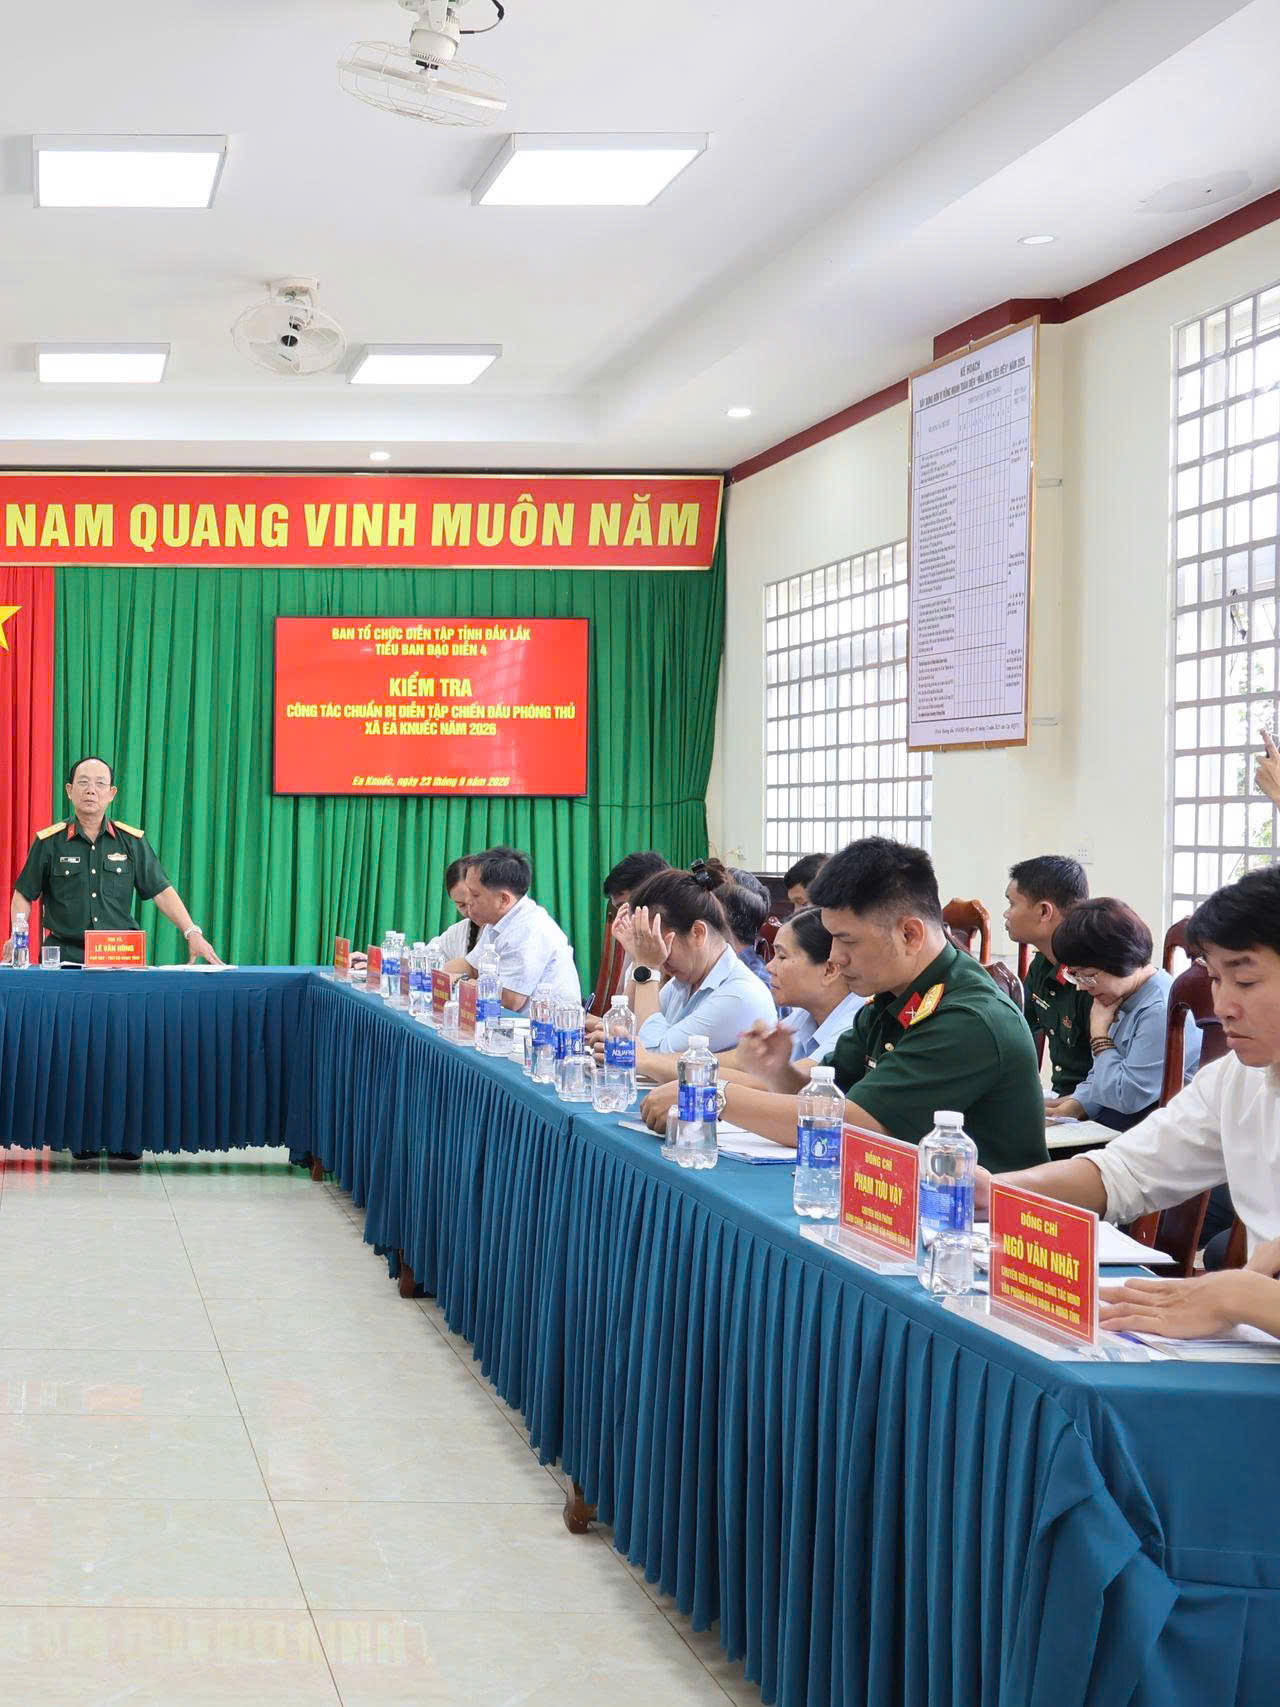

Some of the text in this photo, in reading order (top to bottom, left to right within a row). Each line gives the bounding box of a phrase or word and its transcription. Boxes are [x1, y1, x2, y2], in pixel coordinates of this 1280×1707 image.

[6, 503, 114, 548] NAM
[129, 503, 289, 553] QUANG
[303, 503, 417, 548] VINH
[431, 494, 575, 548] MUÔN
[588, 493, 700, 548] NĂM
[332, 627, 355, 640] BAN
[374, 625, 403, 640] CHỨC
[433, 625, 455, 643] TẬP
[401, 643, 424, 656] BAN
[389, 672, 472, 697] KIỂM TRA
[286, 702, 318, 718] CÔNG
[320, 702, 341, 718] TÁC
[384, 704, 397, 720] BỊ
[427, 703, 449, 720] TẬP
[451, 702, 485, 719] CHIẾN
[554, 702, 576, 719] THỦ
[382, 722, 398, 735] EA
[440, 720, 467, 735] NĂM
[854, 1171, 874, 1196] PHẠM
[1020, 1211, 1058, 1237] ĐỒNG CHÍ
[1003, 1233, 1080, 1284] NGÔ VĂN NHẬT
